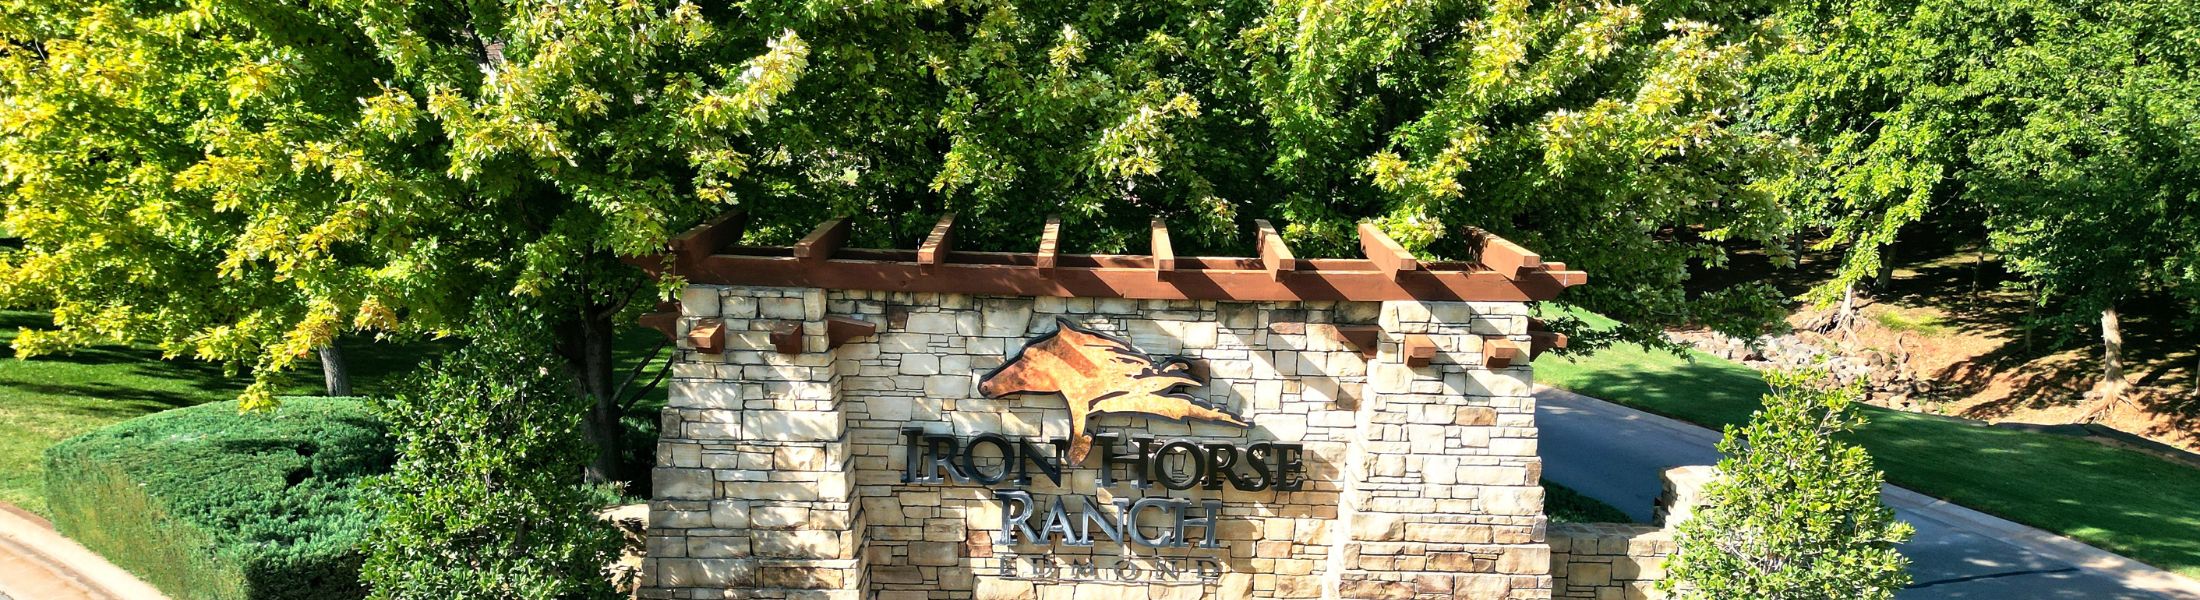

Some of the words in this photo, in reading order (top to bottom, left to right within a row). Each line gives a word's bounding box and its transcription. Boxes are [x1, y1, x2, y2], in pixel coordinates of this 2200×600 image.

[901, 427, 1068, 487] IRON
[1097, 432, 1303, 492] HORSE
[993, 489, 1222, 548] RANCH
[999, 555, 1223, 582] EDMOND
